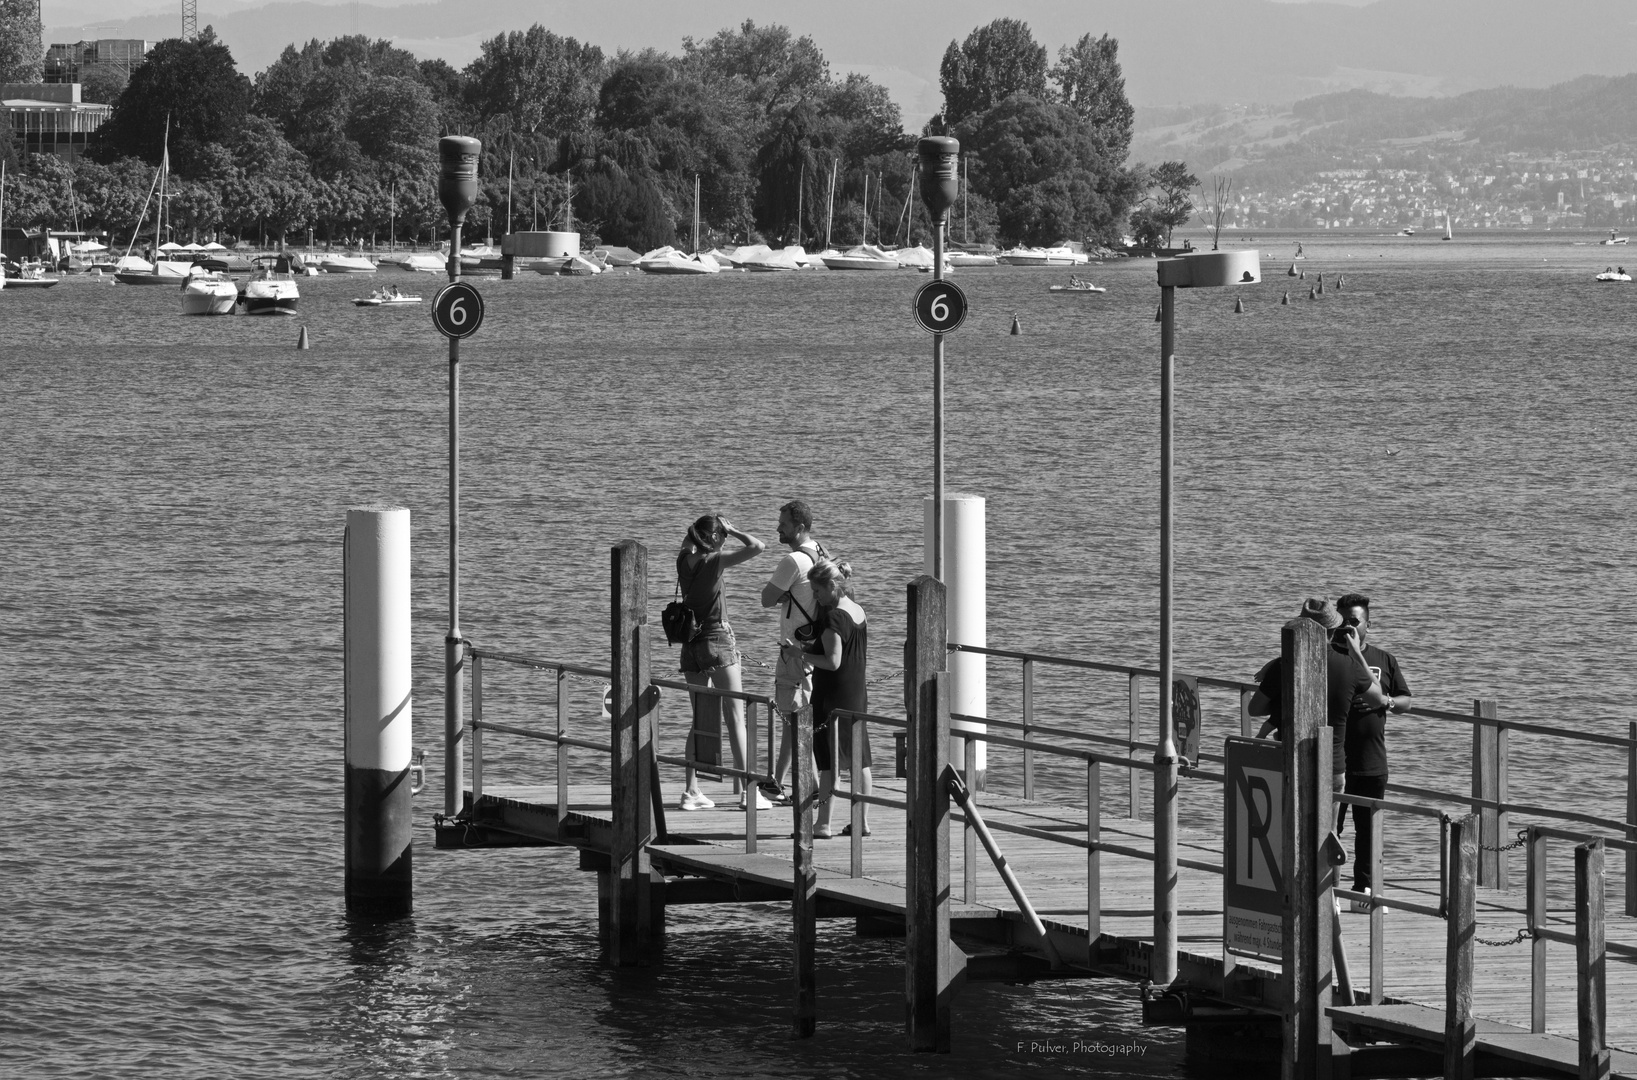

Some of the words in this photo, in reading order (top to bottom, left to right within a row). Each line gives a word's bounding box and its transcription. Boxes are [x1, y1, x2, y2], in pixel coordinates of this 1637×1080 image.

[450, 297, 467, 326] 6
[931, 293, 950, 322] 6
[1228, 915, 1258, 930] ausgenommen
[1234, 931, 1252, 945] während
